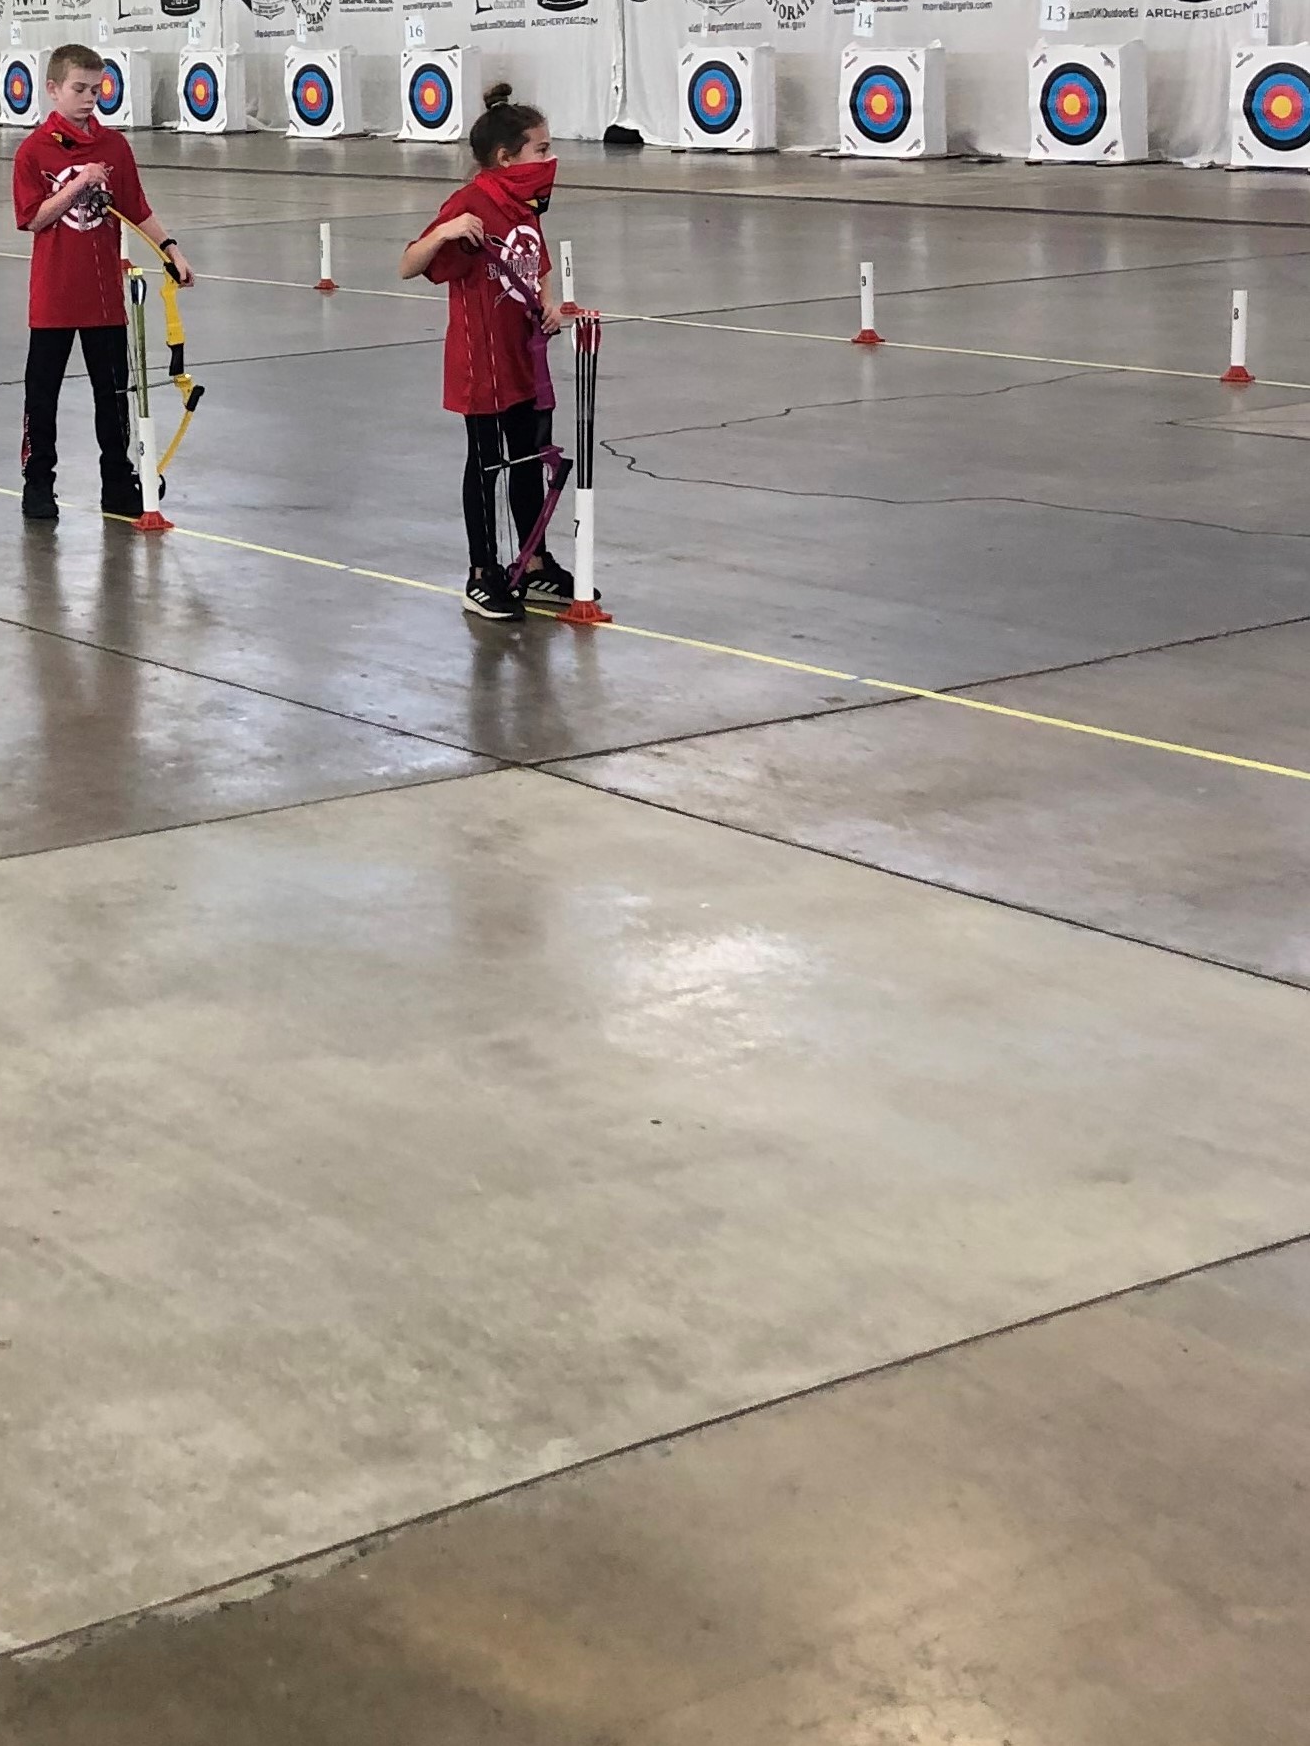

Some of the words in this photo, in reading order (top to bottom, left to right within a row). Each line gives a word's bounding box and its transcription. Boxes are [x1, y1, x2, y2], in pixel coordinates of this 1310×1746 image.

[858, 12, 872, 28] 14
[1046, 5, 1066, 22] 13
[190, 26, 200, 38] 18
[409, 24, 423, 38] 16
[564, 257, 571, 277] 10
[1233, 307, 1239, 320] 8
[574, 519, 580, 538] 7
